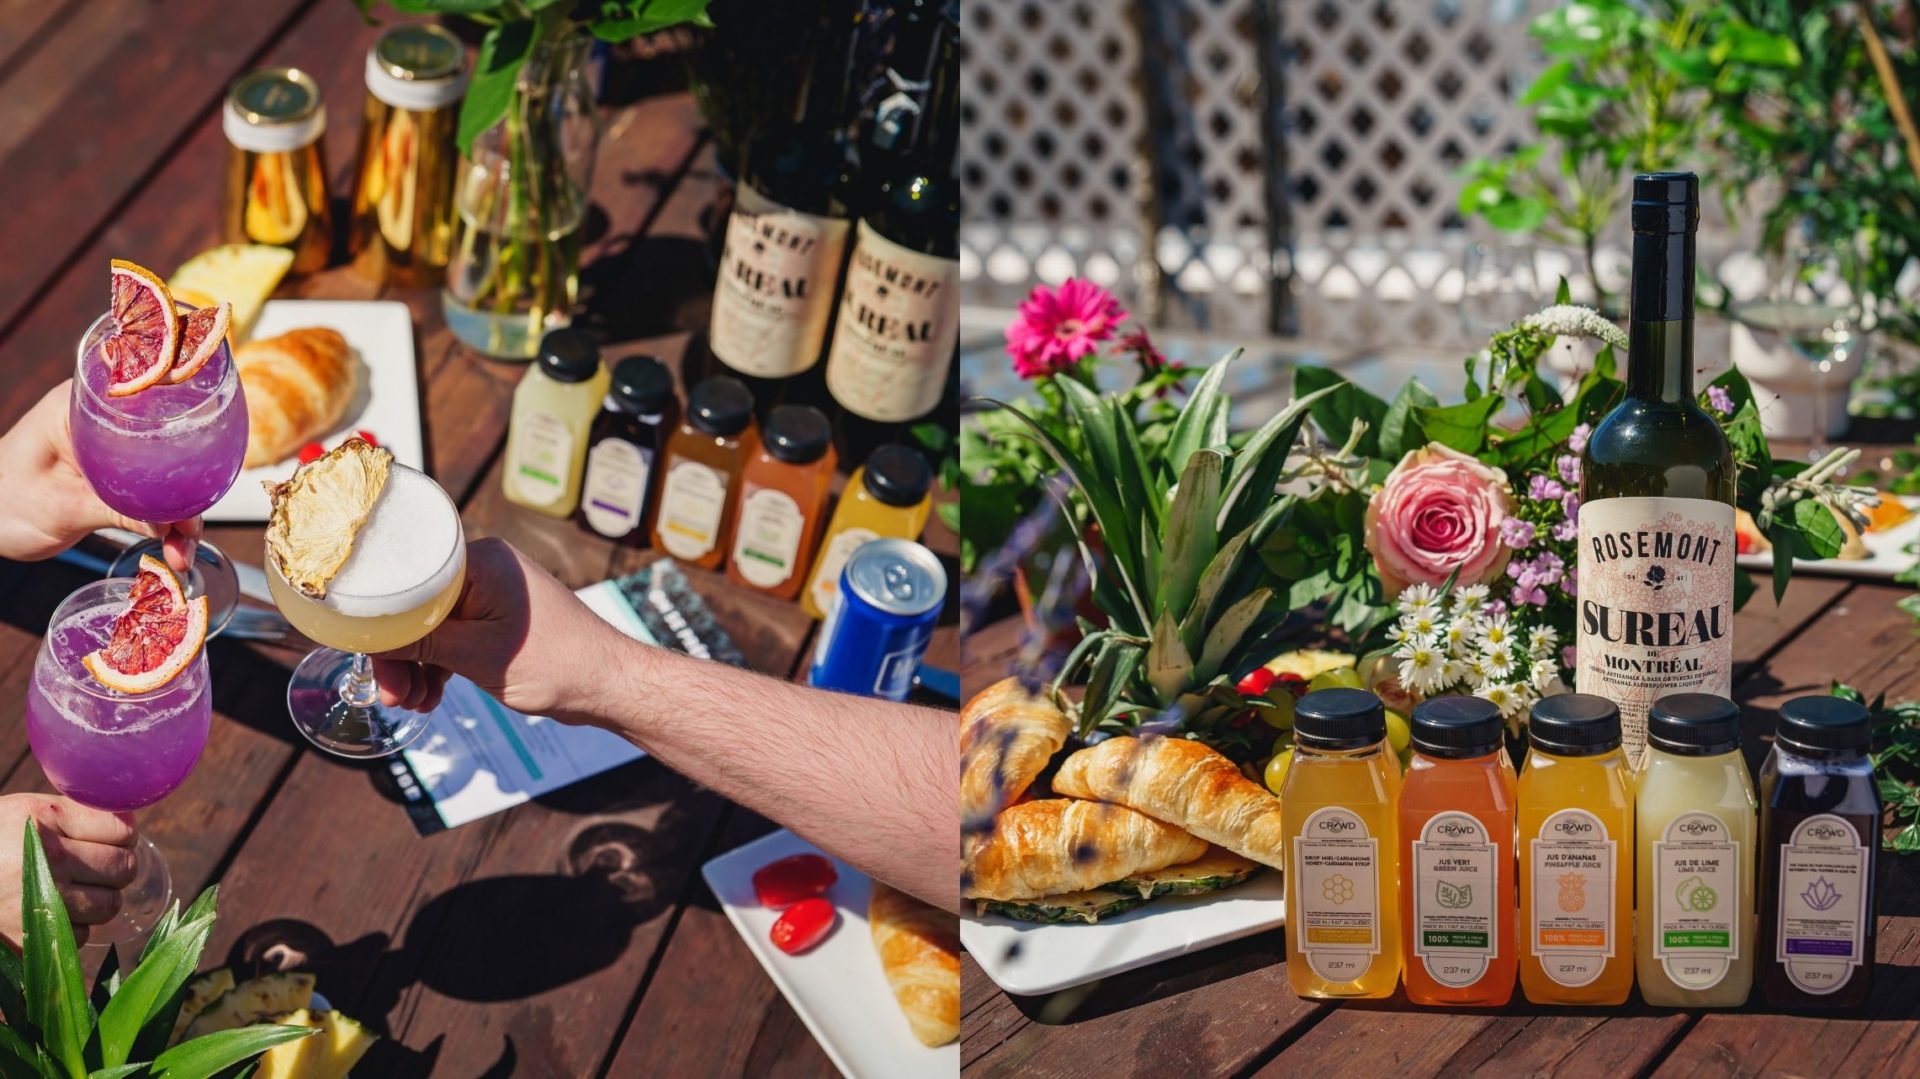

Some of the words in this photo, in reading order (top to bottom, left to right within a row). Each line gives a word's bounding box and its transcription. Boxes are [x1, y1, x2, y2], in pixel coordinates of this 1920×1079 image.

[1592, 531, 1721, 566] ROSEMONT
[1583, 600, 1728, 647] SUREAU
[1604, 654, 1703, 673] MONTRÉAL
[1544, 861, 1580, 869] PINEAPPLE
[1428, 935, 1449, 944] 100%
[1544, 934, 1566, 942] 100%
[1669, 936, 1689, 944] 100%
[1328, 961, 1344, 969] 237
[1559, 964, 1575, 972] 237
[1443, 966, 1459, 974] 237
[1683, 967, 1699, 975] 237
[1804, 971, 1821, 980] 237
